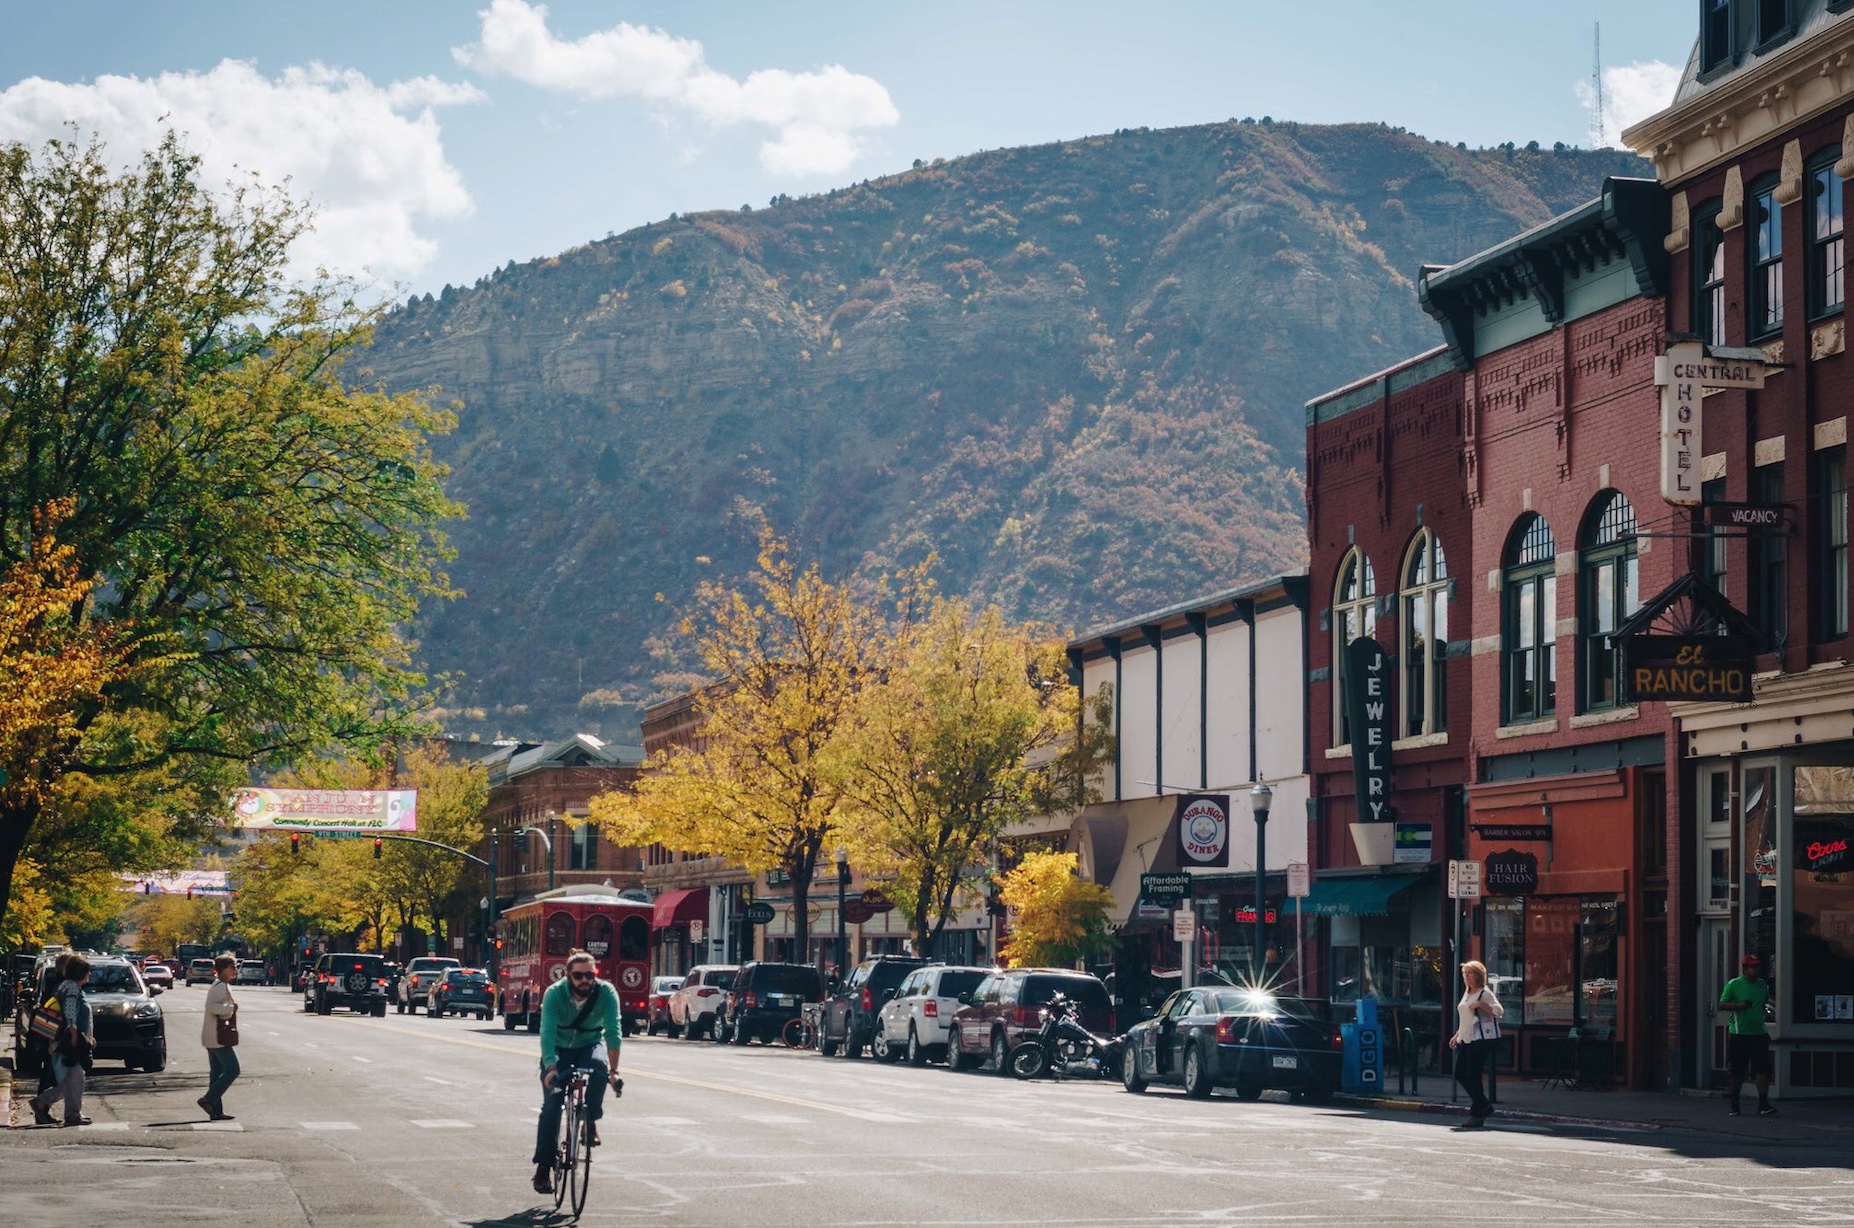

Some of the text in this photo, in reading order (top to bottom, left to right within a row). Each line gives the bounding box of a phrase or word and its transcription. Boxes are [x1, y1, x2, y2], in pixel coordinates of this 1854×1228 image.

[1673, 363, 1757, 382] CENTRAL
[1677, 383, 1693, 492] HOTEL
[1731, 509, 1778, 524] VACANCY
[1675, 644, 1705, 665] El
[1635, 668, 1744, 695] RANCHO
[1366, 653, 1384, 820] JEWELRY
[265, 803, 377, 815] SYMPHONY
[1183, 806, 1225, 823] DURANGO
[273, 818, 312, 827] Community
[313, 819, 340, 827] Concert
[340, 819, 357, 827] Hall
[1187, 842, 1219, 854] DINER
[1806, 839, 1848, 860] Coors
[1494, 863, 1528, 873] HAIR
[1142, 876, 1189, 886] Affordable
[1489, 873, 1533, 883] FUSION
[1148, 885, 1184, 894] Framing
[1361, 1030, 1377, 1082] DGO
